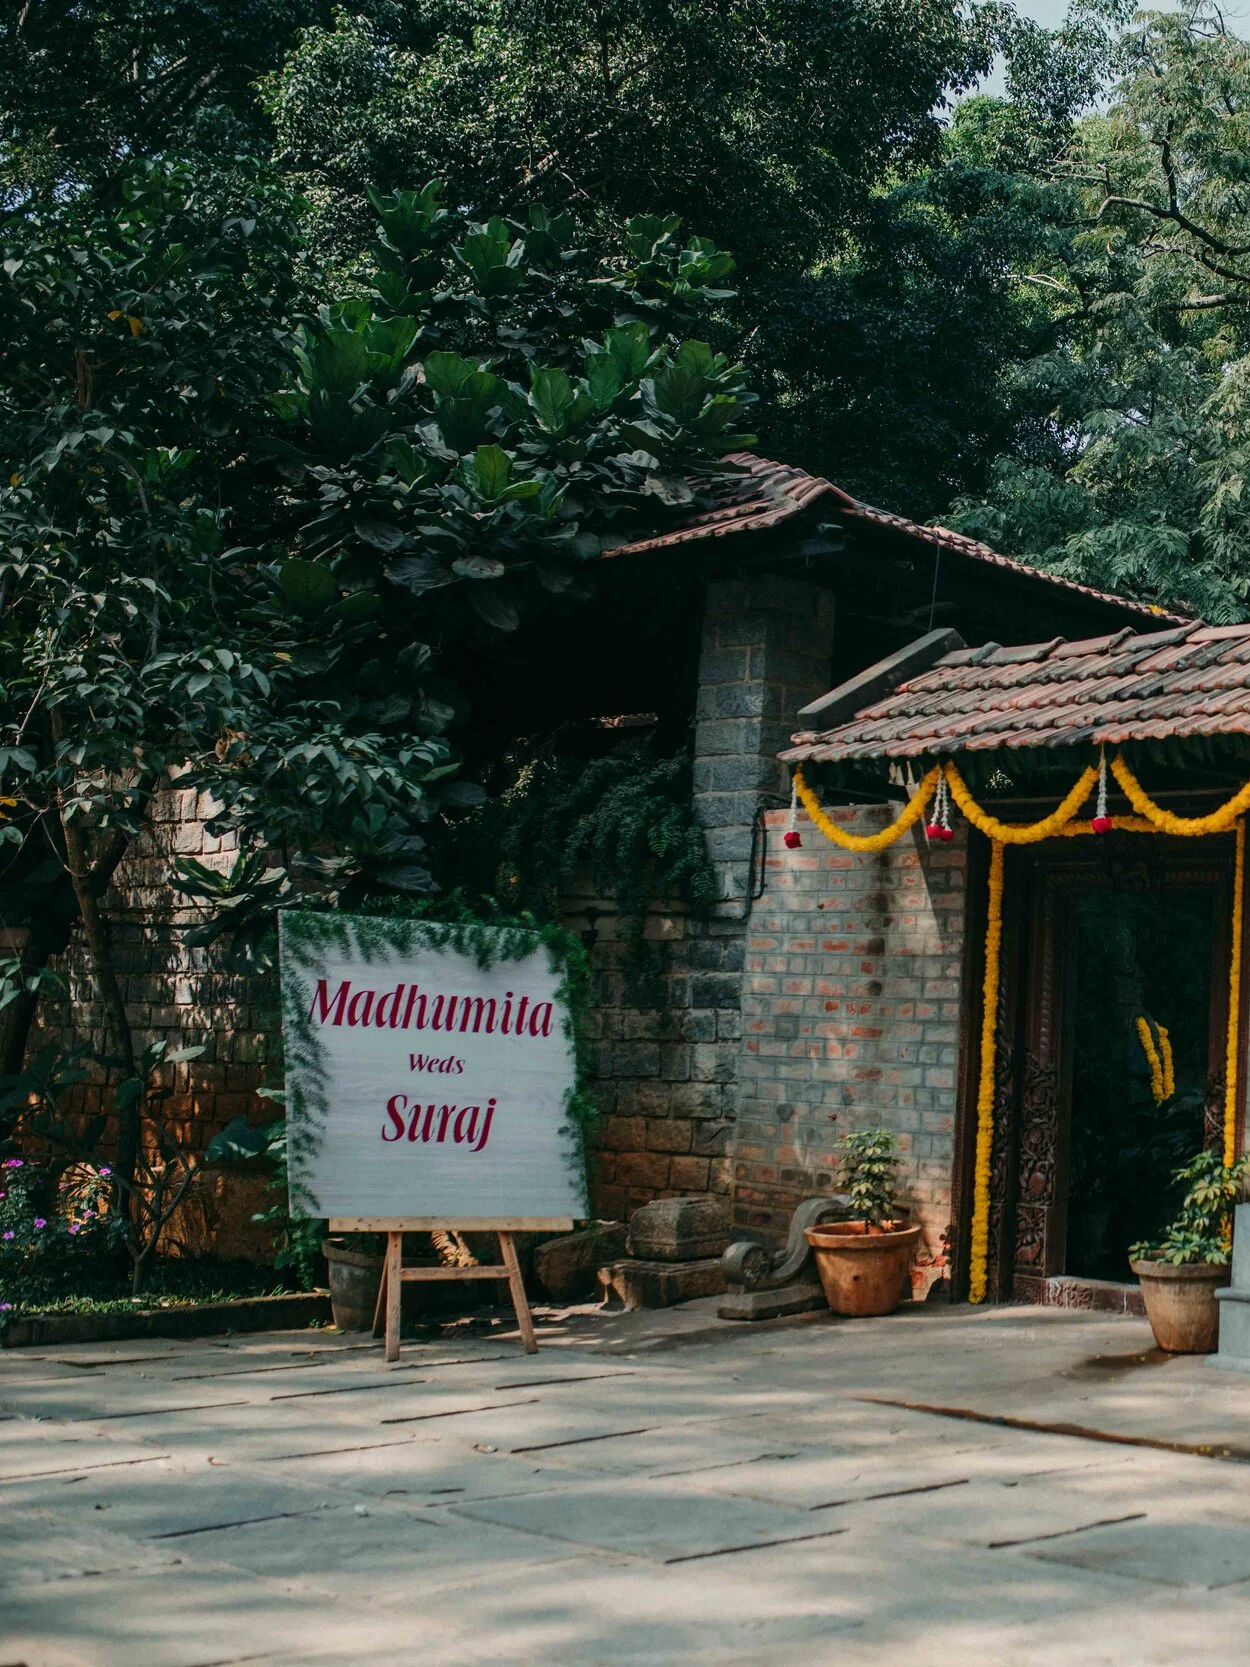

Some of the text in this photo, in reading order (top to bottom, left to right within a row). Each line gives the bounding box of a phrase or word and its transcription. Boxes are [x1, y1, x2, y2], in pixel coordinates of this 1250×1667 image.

[310, 979, 553, 1037] Madhumita
[408, 1053, 466, 1074] Weds
[381, 1094, 497, 1152] Suraj
